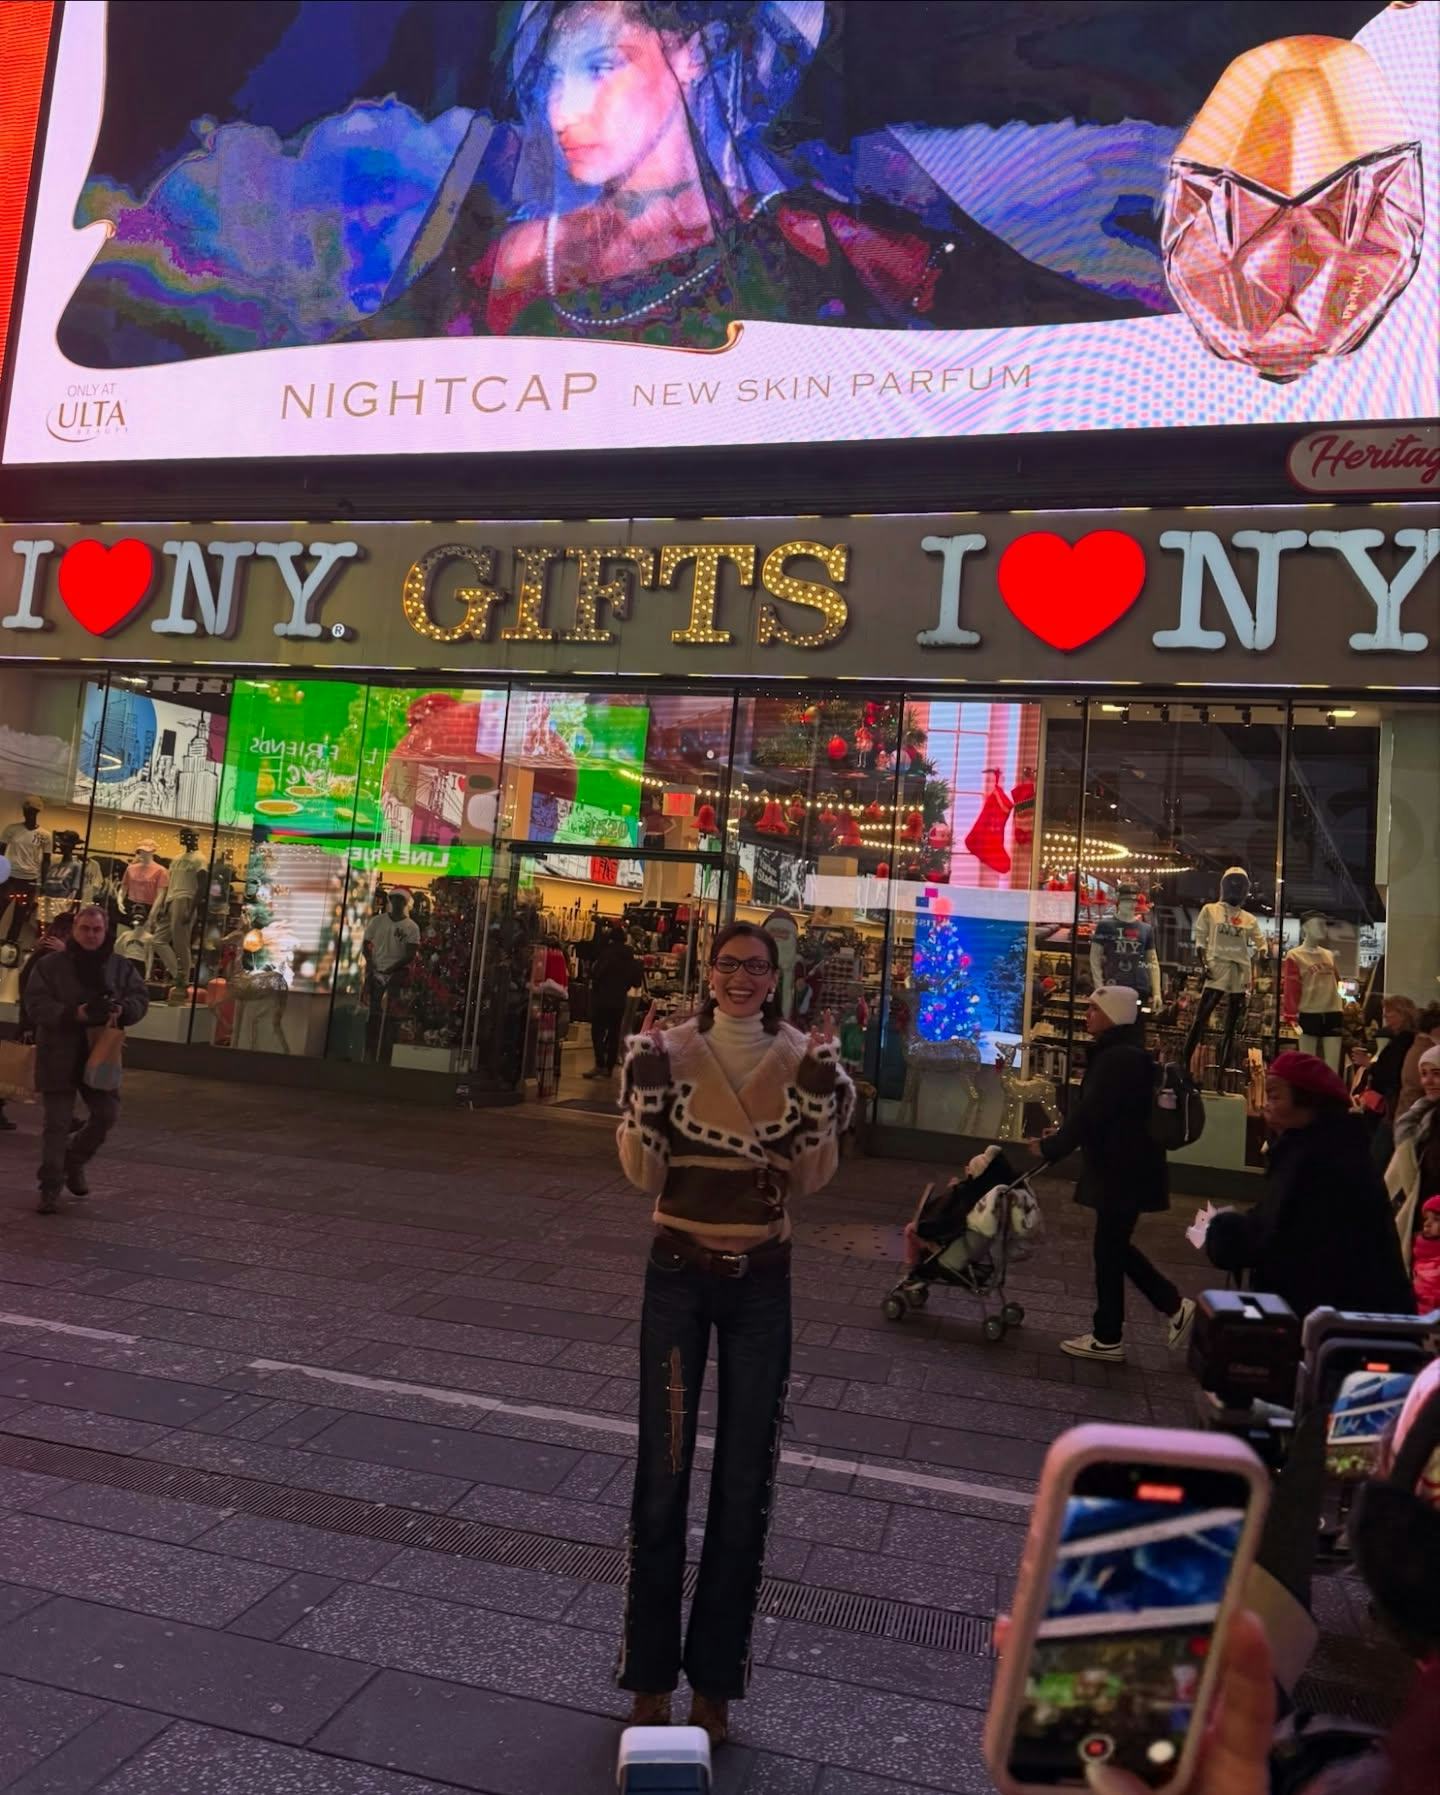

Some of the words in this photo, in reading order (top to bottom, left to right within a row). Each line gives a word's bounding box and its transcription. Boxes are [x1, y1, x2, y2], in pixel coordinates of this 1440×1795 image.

[67, 383, 100, 398] ONLY
[102, 382, 119, 396] AT
[280, 371, 599, 421] NIGHTCAP
[632, 381, 721, 407] NEW
[737, 375, 832, 402] SKIN
[851, 364, 1032, 397] PARFUM
[58, 400, 126, 428] ULTA
[2, 538, 57, 632] I
[150, 538, 362, 640] NY
[402, 540, 850, 648] GIFTS
[917, 533, 988, 648] I
[1151, 528, 1440, 652] NY
[1115, 940, 1141, 954] NY
